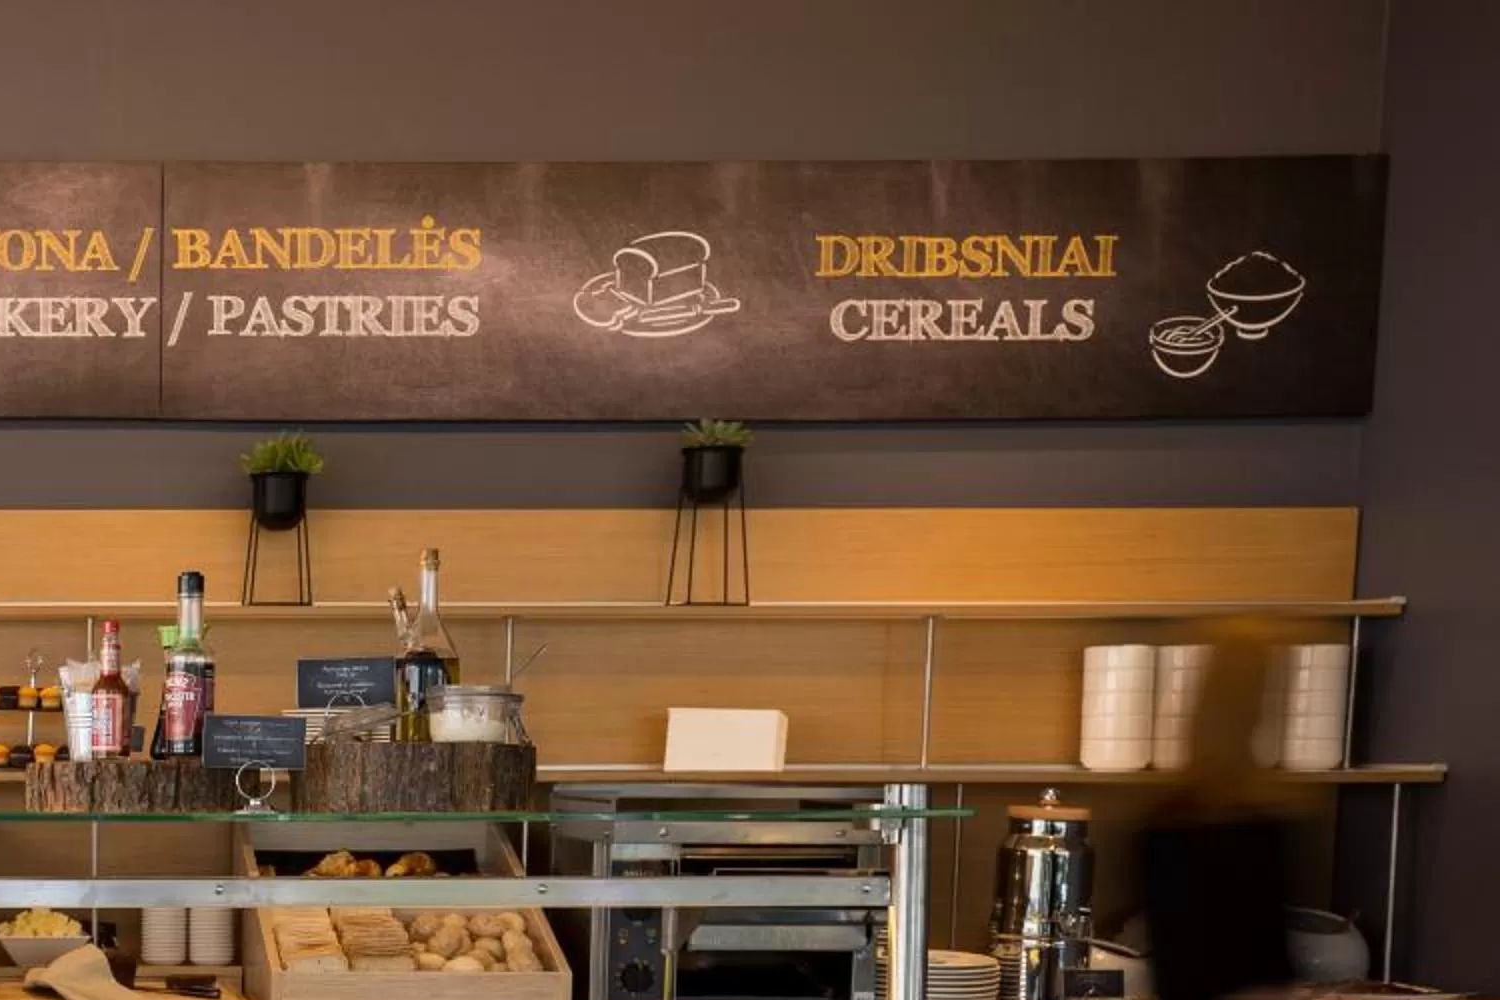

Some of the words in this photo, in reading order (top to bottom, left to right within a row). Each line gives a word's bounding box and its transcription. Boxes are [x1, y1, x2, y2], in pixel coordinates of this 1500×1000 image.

[172, 216, 482, 270] BANDELĖS
[815, 235, 1118, 277] DRIBSNIAI
[207, 295, 481, 337] PASTRIES
[829, 298, 1096, 341] CEREALS
